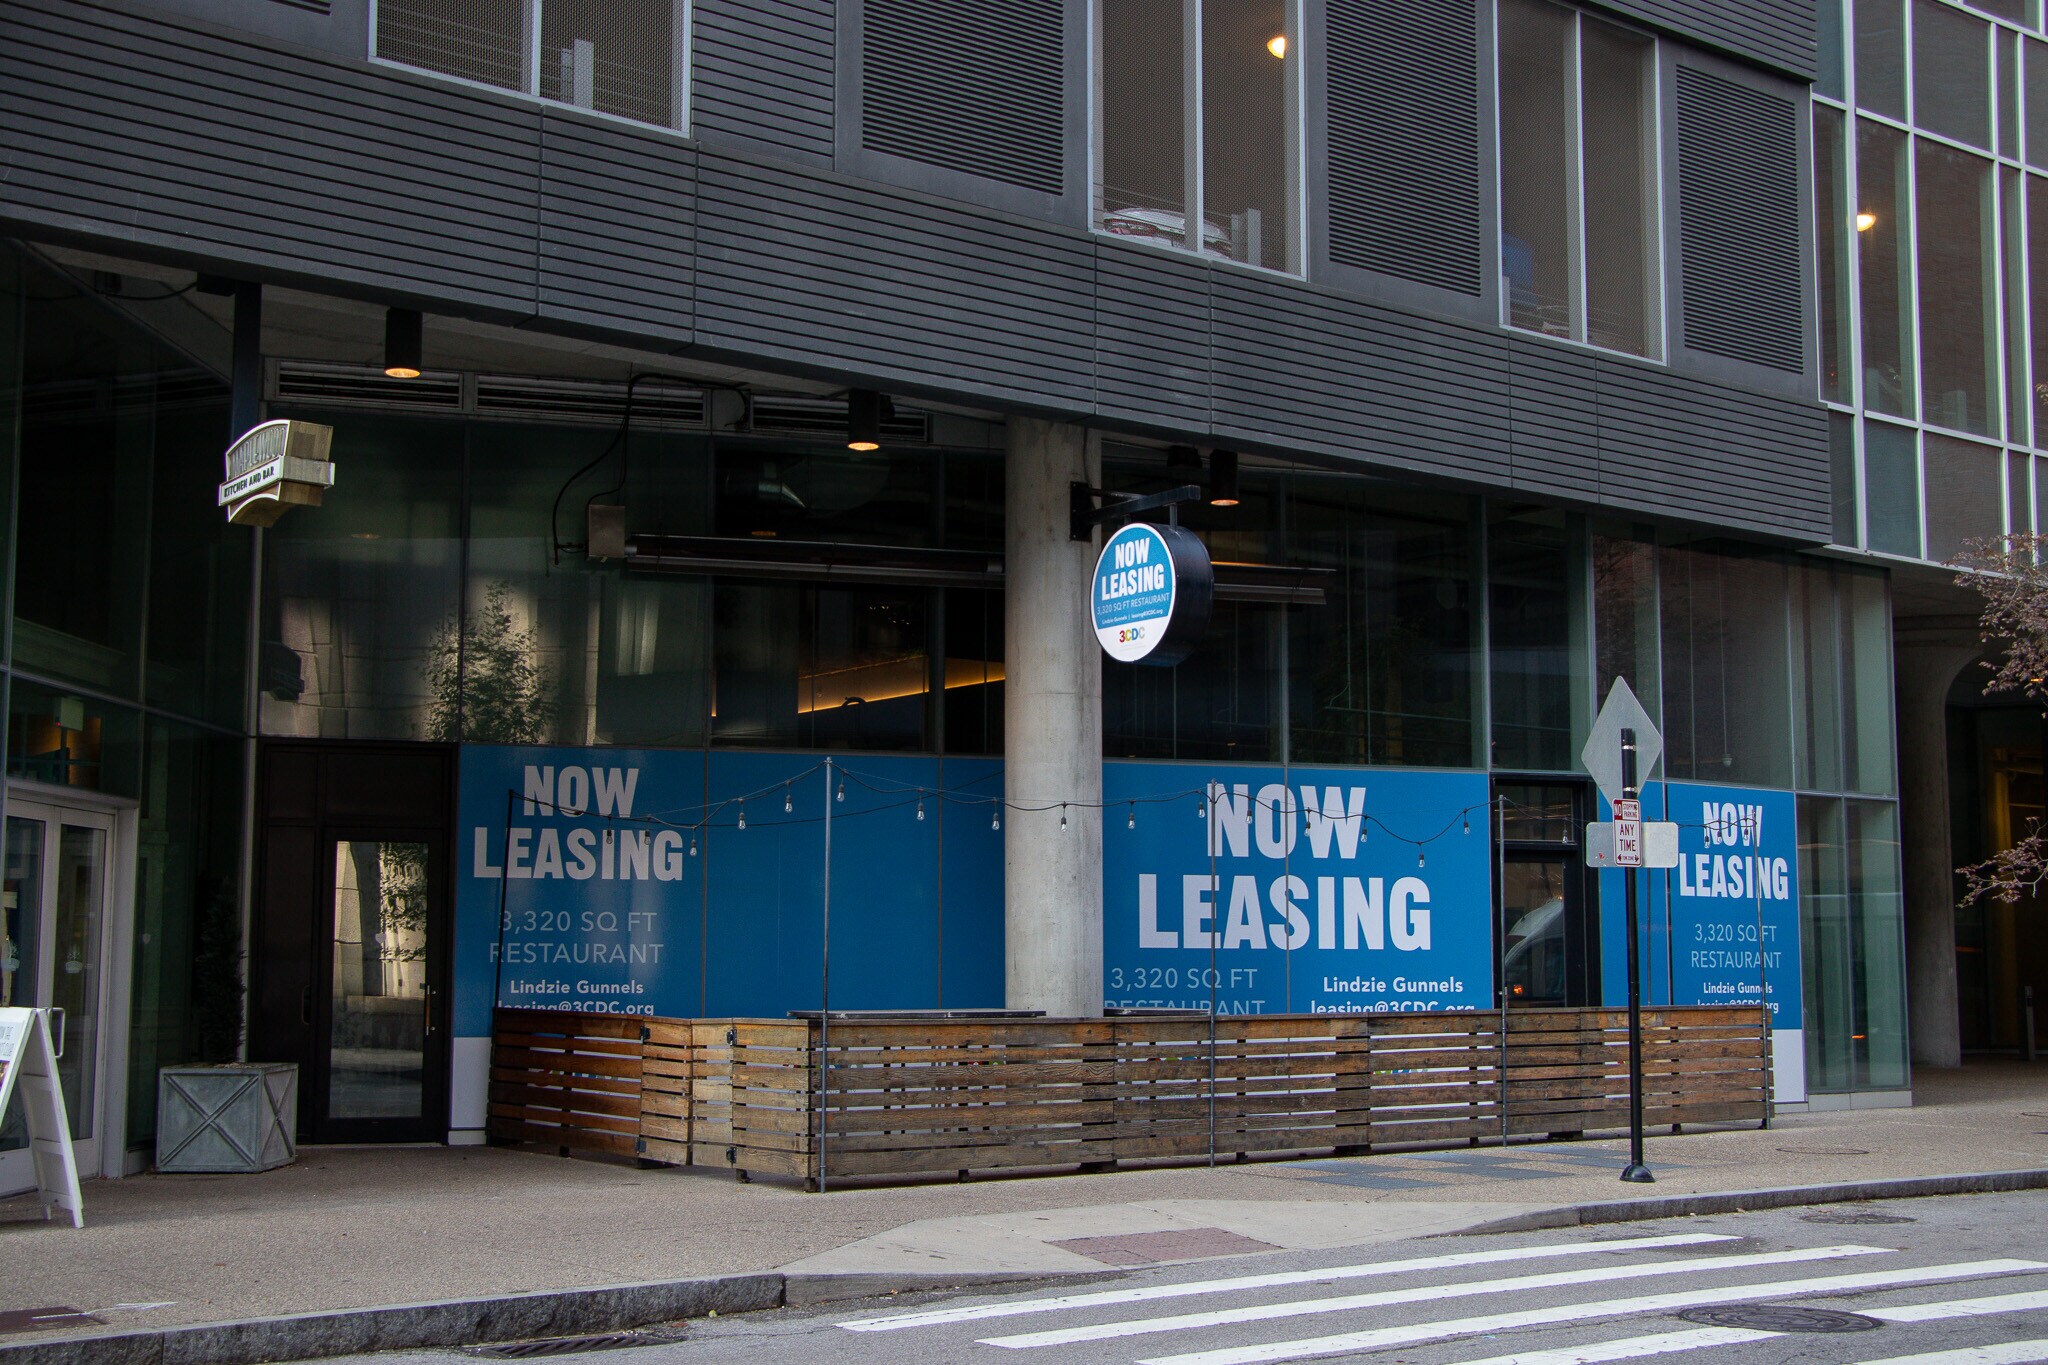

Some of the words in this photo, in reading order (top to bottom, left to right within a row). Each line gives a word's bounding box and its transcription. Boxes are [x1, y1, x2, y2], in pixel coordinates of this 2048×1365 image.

[224, 478, 248, 498] KITCHEN
[249, 472, 261, 486] AND
[263, 466, 274, 480] BAR
[1115, 537, 1150, 570] NOW
[1102, 564, 1164, 601] LEASING
[1113, 602, 1121, 611] SQ
[1123, 600, 1130, 609] FT
[1131, 592, 1170, 607] RESTAURANT
[1119, 626, 1145, 642] 3CDC
[524, 765, 639, 818] NOW
[1614, 803, 1622, 816] NO
[1207, 783, 1366, 859] NOW
[1620, 824, 1634, 836] ANY
[1703, 802, 1763, 847] NOW
[474, 826, 682, 881] LEASING
[1620, 839, 1636, 851] TIME
[1679, 852, 1789, 900] LEASING
[498, 910, 570, 934] 3,320
[581, 911, 618, 932] SQ
[628, 912, 658, 932] FT
[1138, 874, 1431, 951] LEASING
[1695, 924, 1733, 943] 3,320
[1738, 924, 1757, 942] SQ
[1762, 926, 1776, 942] FT
[490, 943, 664, 963] RESTAURANT
[1691, 950, 1782, 968] RESTAURANT
[511, 980, 570, 994] Lindzie
[576, 980, 644, 994] Gunnels
[1111, 968, 1178, 992] 3,320
[1187, 968, 1222, 989] SQ
[1231, 968, 1258, 989] FT
[1324, 976, 1386, 992] Lindzie
[1393, 976, 1463, 993] Gunnels
[1704, 982, 1735, 994] Lindzie
